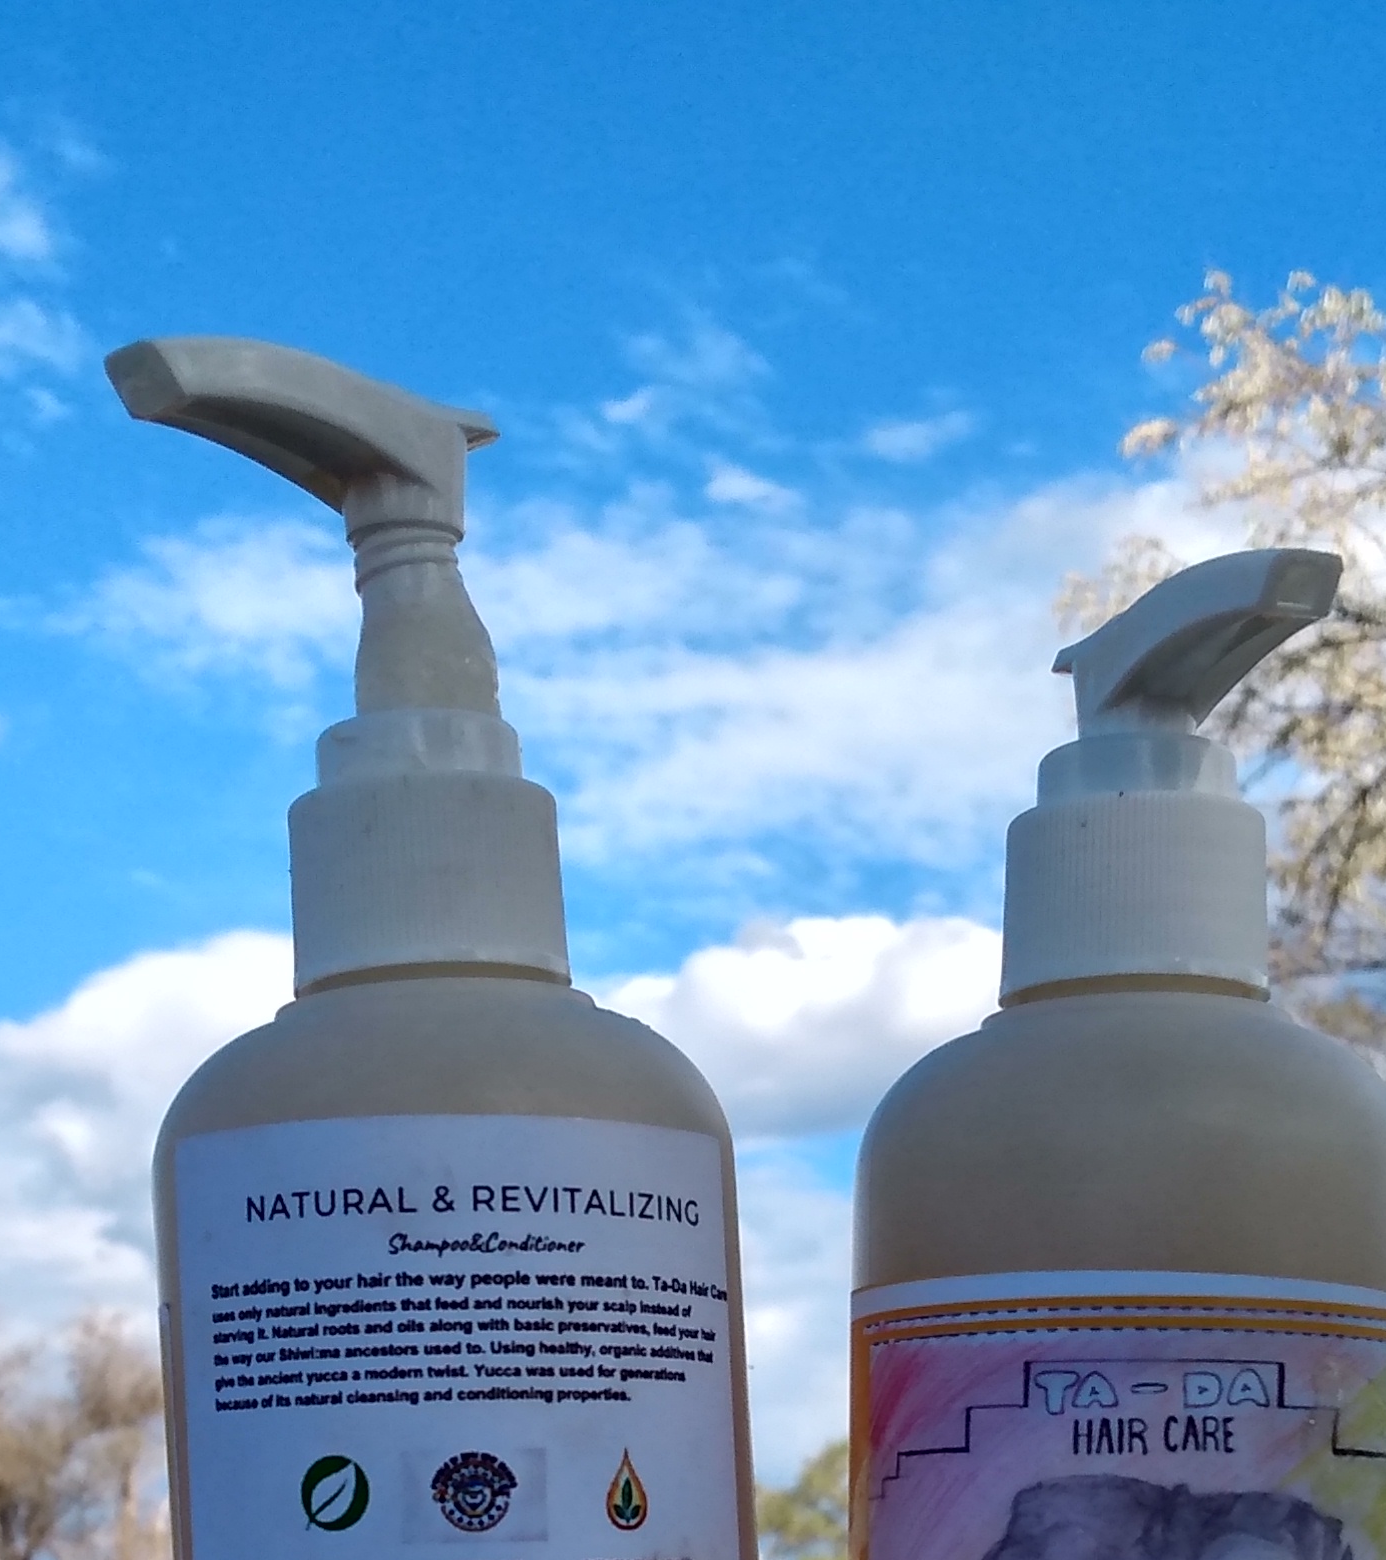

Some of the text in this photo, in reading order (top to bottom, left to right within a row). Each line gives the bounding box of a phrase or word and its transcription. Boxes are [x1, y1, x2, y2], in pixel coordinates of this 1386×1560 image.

[246, 1185, 701, 1227] NATURAL & REVITALIZING
[211, 1283, 240, 1300] Start
[242, 1279, 290, 1297] adding
[294, 1278, 309, 1292] to
[314, 1276, 353, 1294] your
[356, 1273, 392, 1289] hair
[395, 1271, 424, 1287] the
[429, 1273, 465, 1289] way
[471, 1270, 531, 1289] people
[535, 1274, 575, 1286] were
[581, 1275, 627, 1289] meant
[631, 1275, 649, 1290] to.
[652, 1275, 687, 1294] Ta-Da
[689, 1281, 709, 1297] Hair
[212, 1296, 692, 1323] uses only natural ingredients that feed and nourish your scalp instead of
[213, 1329, 255, 1344] starving
[258, 1327, 269, 1340] it.
[272, 1323, 319, 1339] Natural
[322, 1322, 360, 1336] roots
[364, 1320, 393, 1334] and
[397, 1320, 425, 1333] oils
[429, 1319, 473, 1334] along
[478, 1318, 509, 1331] with
[514, 1318, 554, 1332] basic
[558, 1319, 651, 1336] preservatives,
[653, 1322, 677, 1337] feed
[678, 1328, 699, 1340] your
[232, 1355, 252, 1367] way
[255, 1352, 276, 1363] our
[344, 1343, 419, 1359] ancestors
[423, 1342, 461, 1355] used
[466, 1342, 485, 1354] to.
[489, 1341, 535, 1358] Using
[539, 1341, 596, 1358] healthy,
[599, 1343, 647, 1359] organic
[650, 1346, 695, 1361] additives
[697, 1349, 714, 1364] that
[215, 1364, 686, 1392] give the ancient yucca a modern twist. Yucca was used for generations
[215, 1387, 632, 1412] because of its natural cleansing and conditioning properties.
[1073, 1415, 1236, 1456] HAIR CARE
